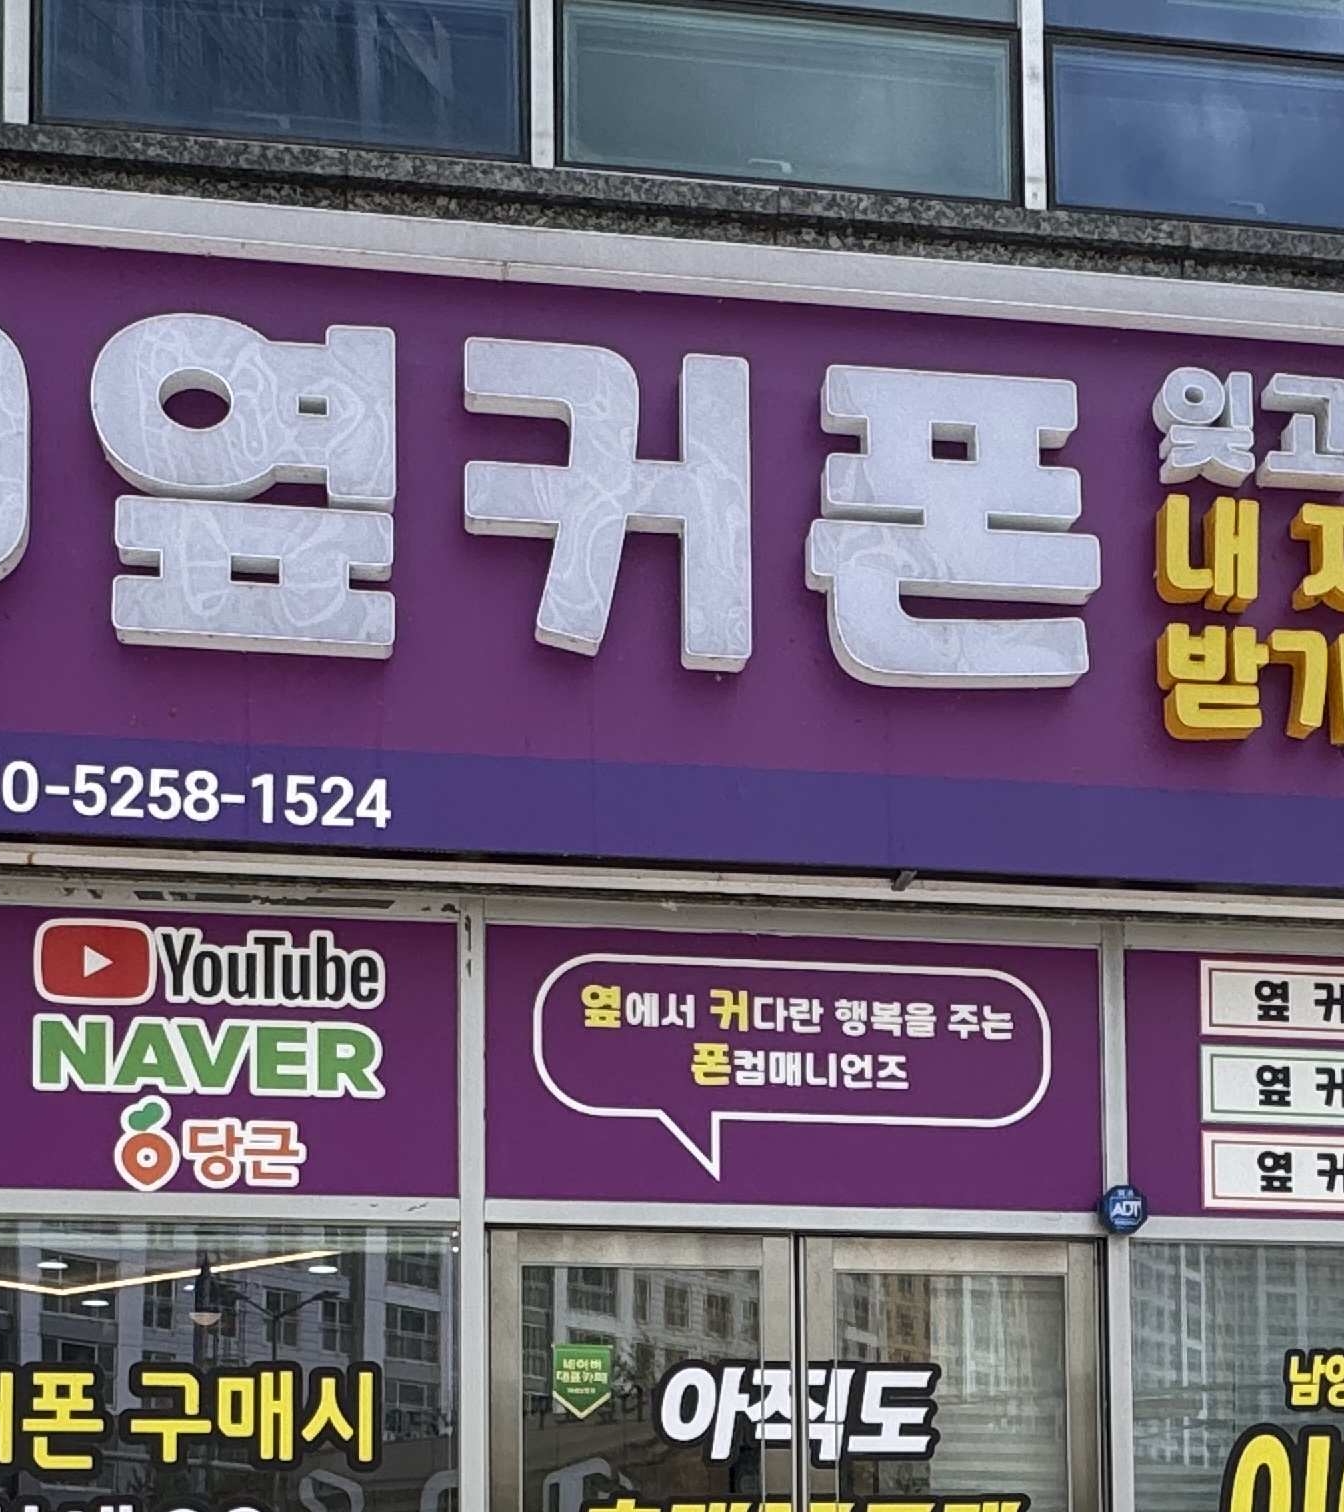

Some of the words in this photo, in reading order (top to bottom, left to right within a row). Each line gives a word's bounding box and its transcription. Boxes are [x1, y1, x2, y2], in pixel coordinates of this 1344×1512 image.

[91, 312, 1100, 688] 옆커폰
[1154, 494, 1259, 613] 내
[161, 933, 379, 1001] YouTube
[581, 984, 695, 1030] 옆에서
[710, 989, 824, 1033] 커다란
[834, 998, 937, 1037] 행복을
[948, 1004, 1014, 1040] 주는
[39, 1019, 376, 1092] NAVER
[691, 1042, 909, 1090] 폰컴매니언즈
[188, 1125, 300, 1182] 당근
[1111, 1200, 1142, 1217] ADT
[131, 1369, 374, 1463] 구매시
[660, 1366, 934, 1460] 아직도
